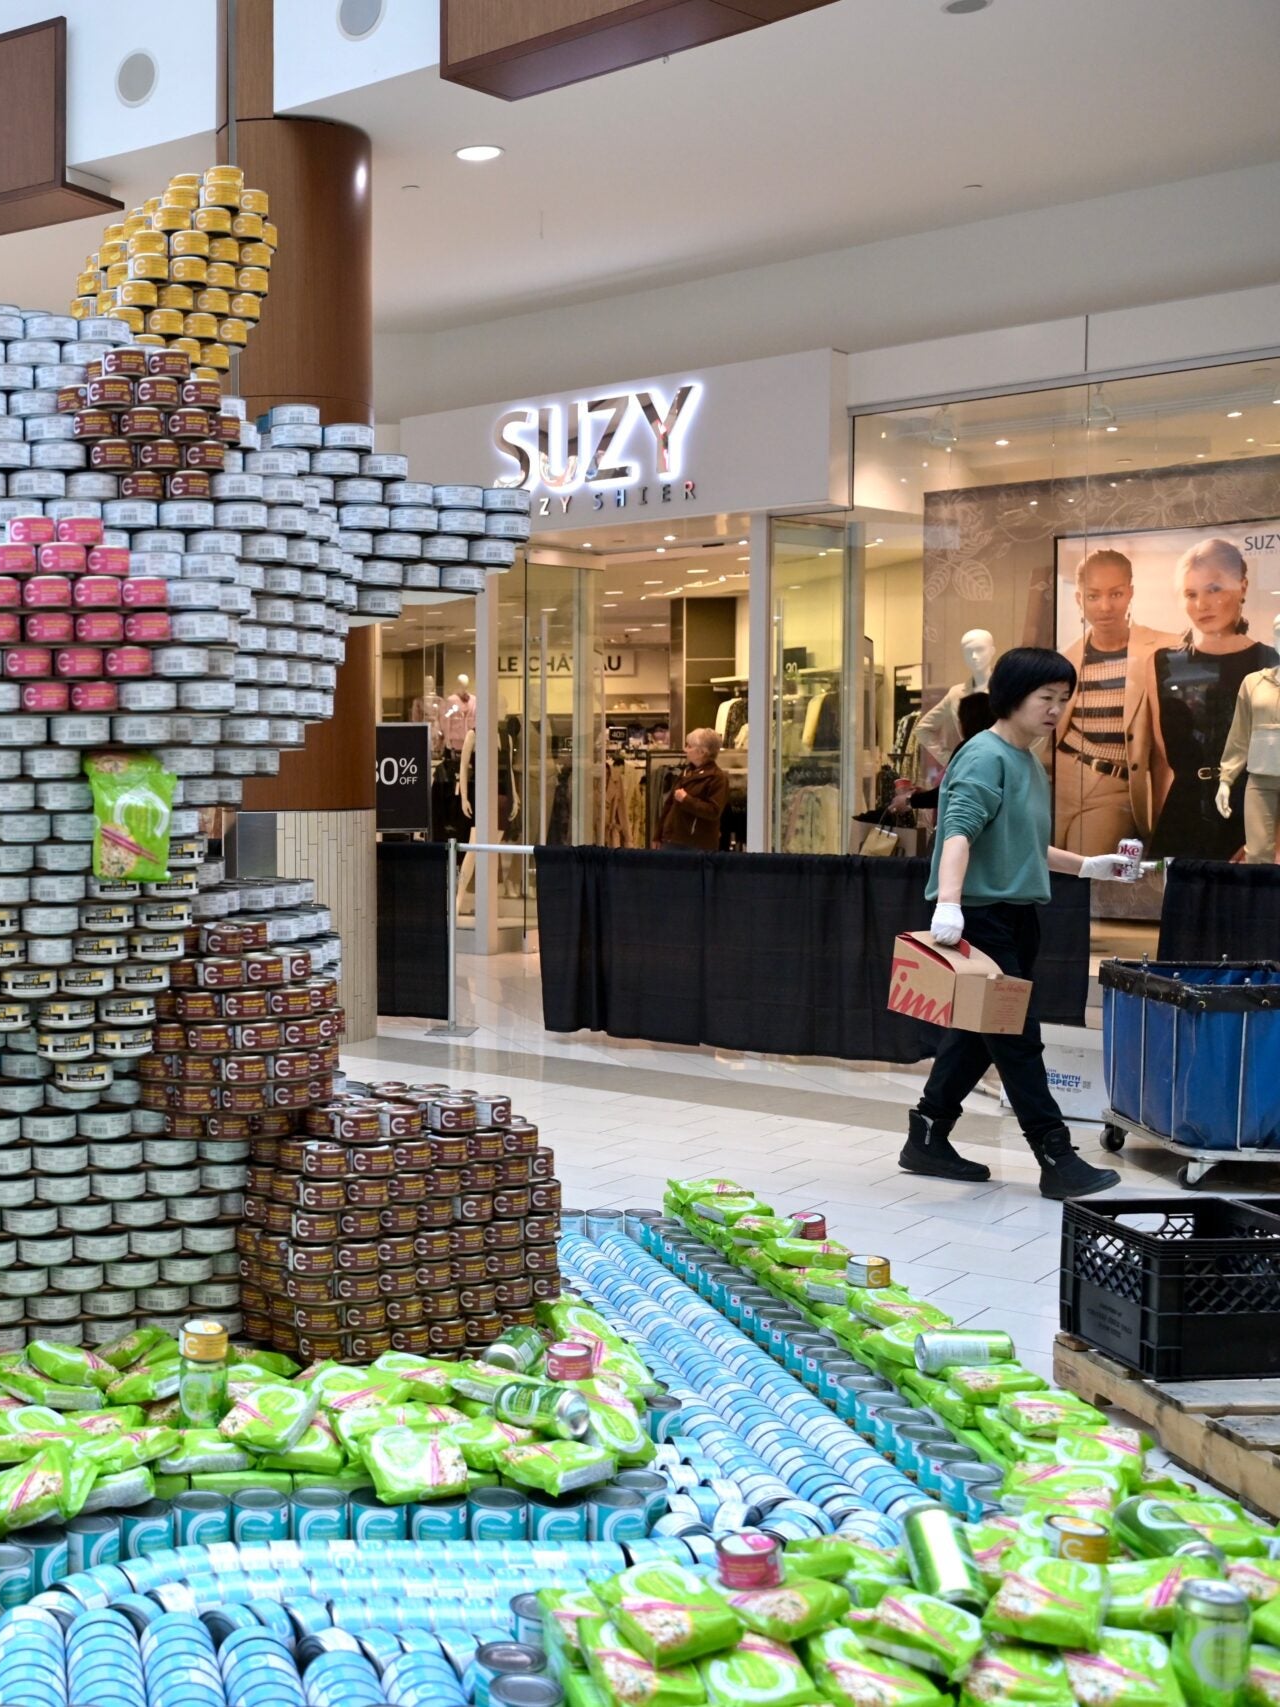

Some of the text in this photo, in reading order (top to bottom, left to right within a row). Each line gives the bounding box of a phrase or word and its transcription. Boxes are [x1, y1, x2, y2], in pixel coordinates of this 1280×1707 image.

[493, 385, 697, 489] SUZY
[539, 480, 697, 516] ZY SHIER
[498, 656, 519, 672] LE
[376, 757, 418, 786] 0%
[399, 776, 418, 785] OFF
[1119, 844, 1140, 857] oke
[888, 957, 952, 1027] Tims
[1061, 1073, 1081, 1081] WITH
